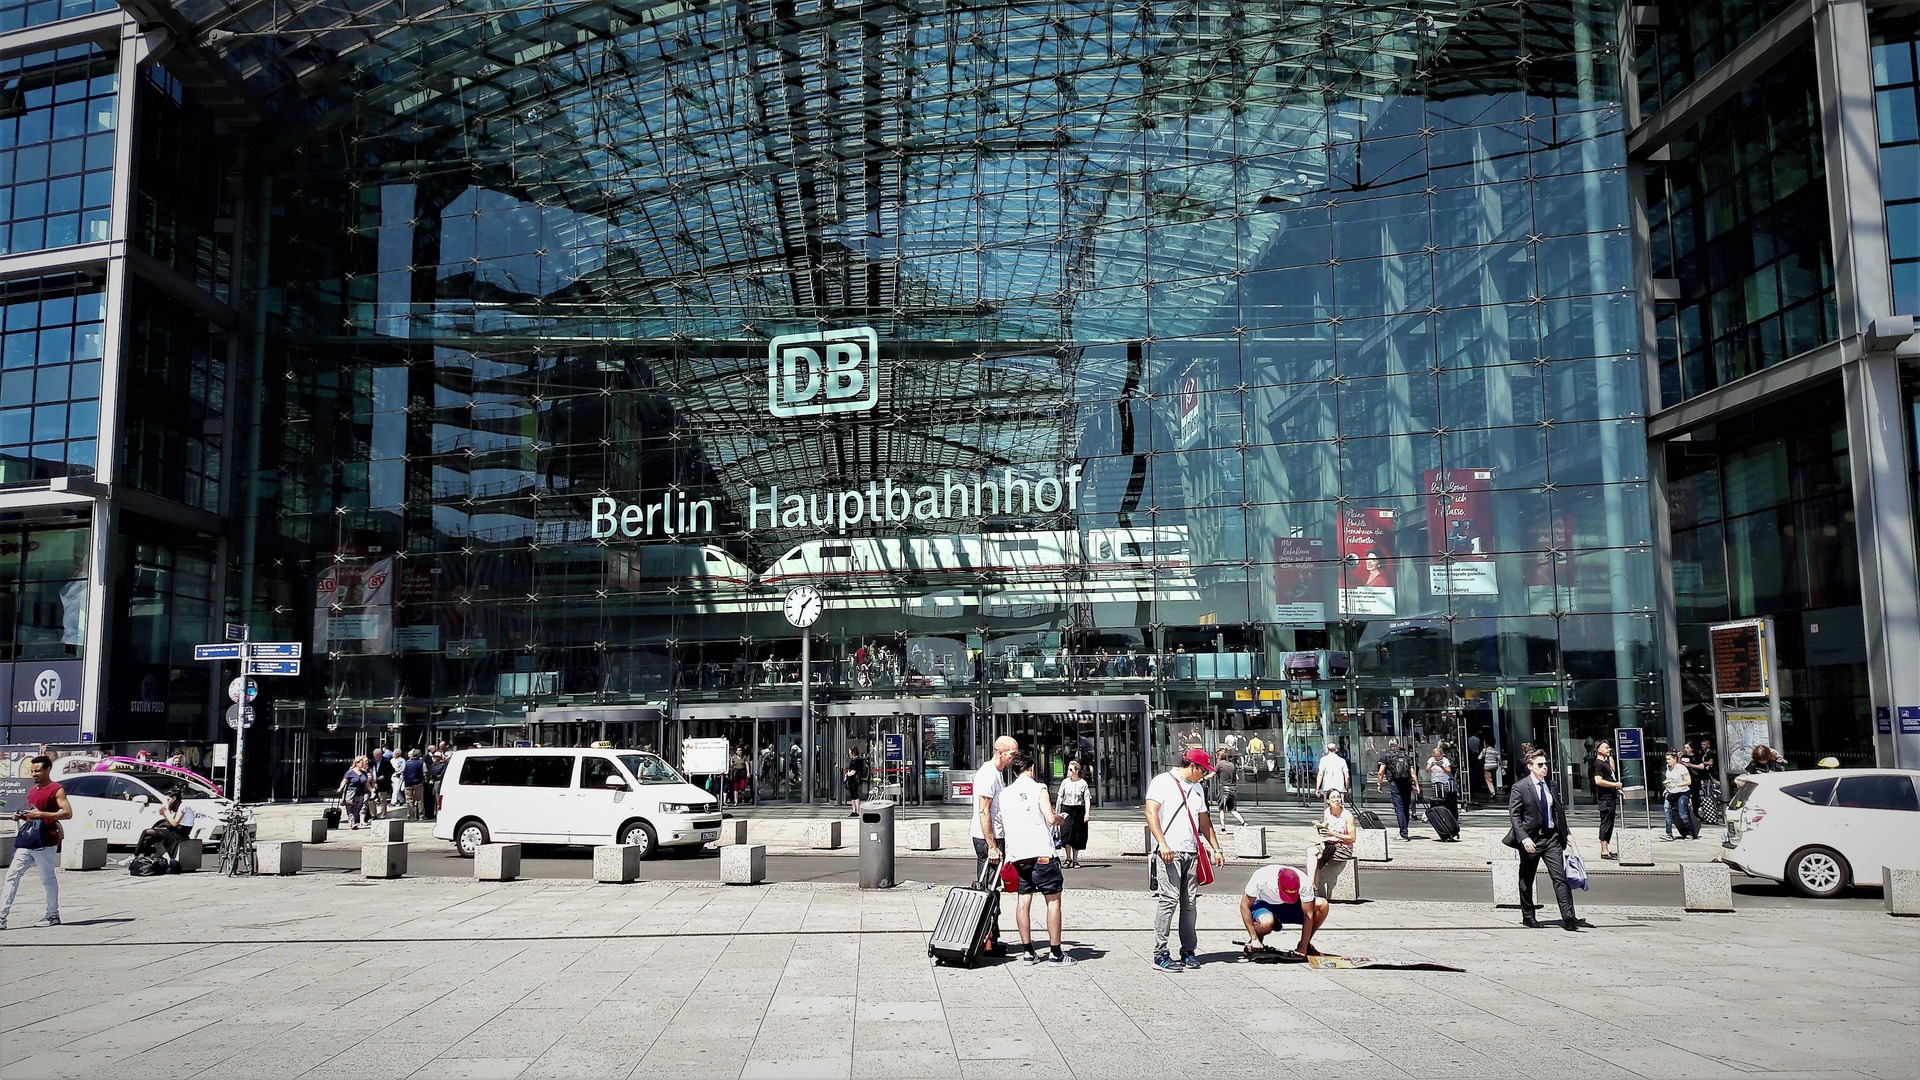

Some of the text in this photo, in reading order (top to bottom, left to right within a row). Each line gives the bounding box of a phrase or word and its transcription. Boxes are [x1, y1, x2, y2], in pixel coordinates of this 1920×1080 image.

[783, 342, 865, 402] DB
[1436, 471, 1451, 481] Mt
[591, 463, 1083, 540] Berlin Hauptbahnhof
[39, 678, 57, 698] SF
[17, 699, 76, 713] STATION FOOD
[130, 700, 151, 713] STATION
[95, 817, 131, 832] mytaxi
